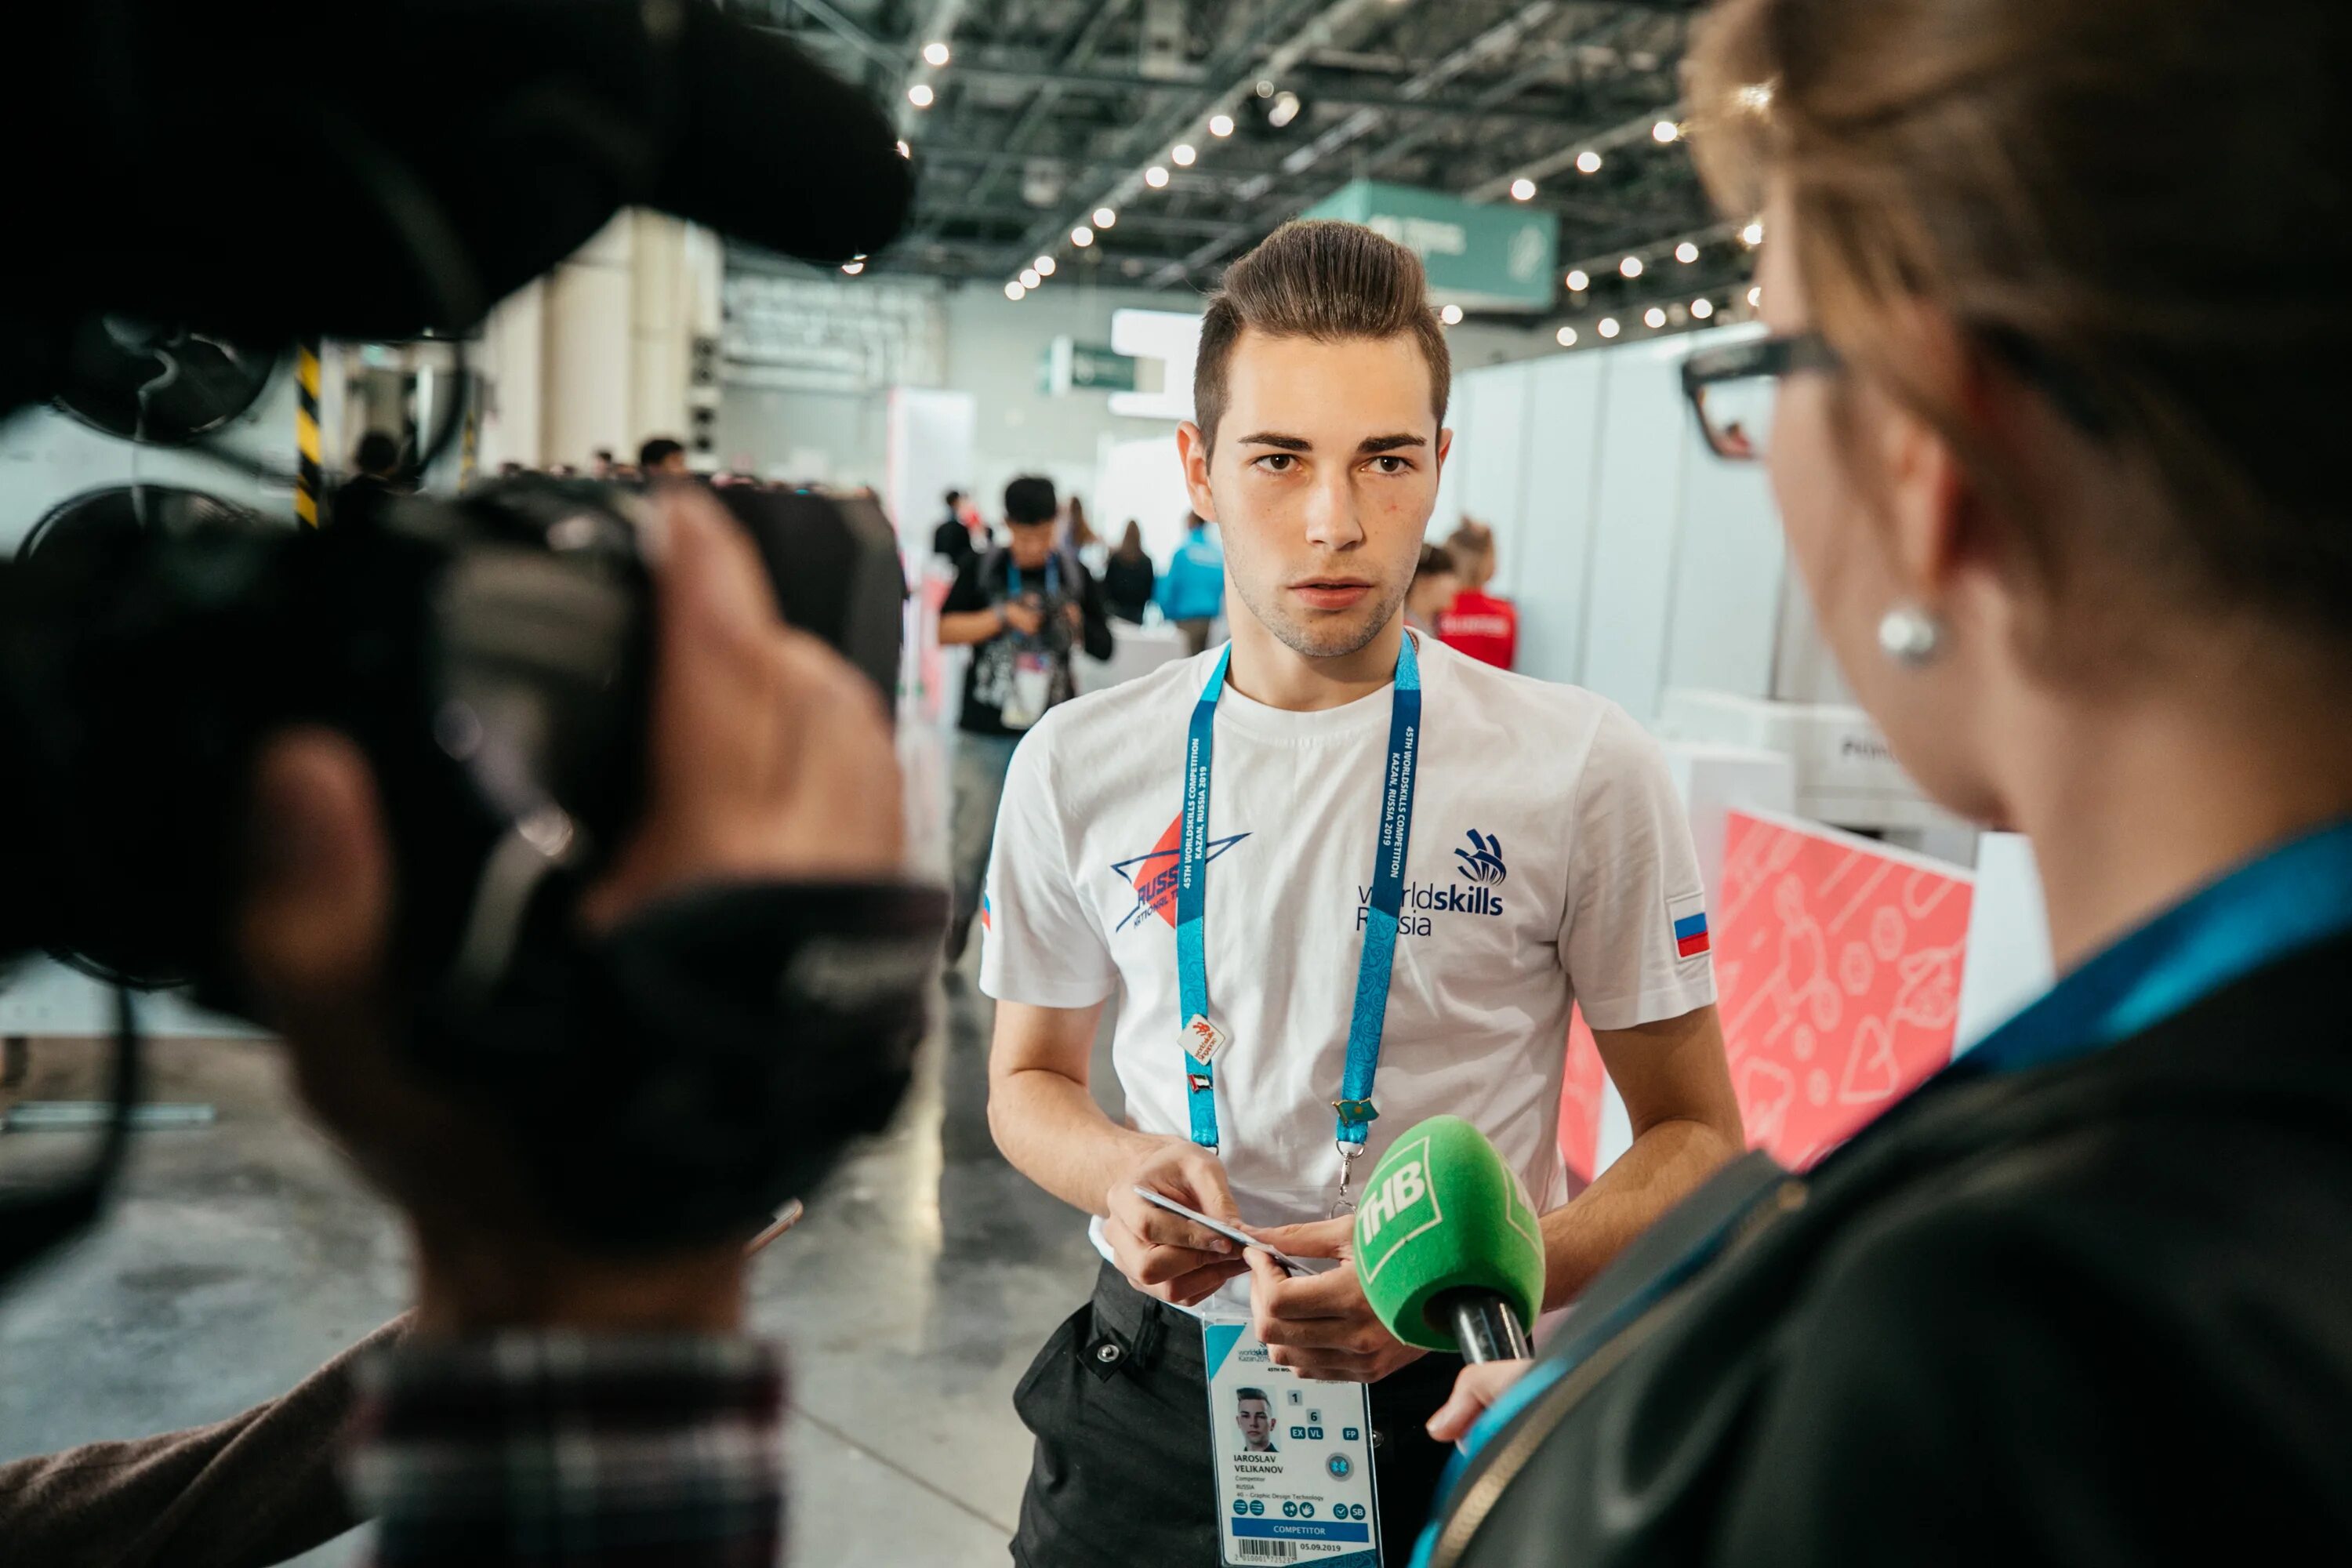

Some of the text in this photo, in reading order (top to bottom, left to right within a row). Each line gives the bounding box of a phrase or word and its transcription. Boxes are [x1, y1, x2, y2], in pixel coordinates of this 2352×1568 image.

[1183, 739, 1200, 890] 45TH WORLDSKILLS COMPETITION
[1194, 766, 1207, 859] KAZAN, RUSSIA 2019
[1383, 753, 1400, 846] KAZAN, RUSSIA 2019
[1390, 726, 1414, 878] 45TH WORLDSKILLS COMPETITION
[1138, 863, 1178, 905] RUSS
[1358, 881, 1504, 916] wrldskills
[1134, 895, 1169, 929] NATIONAL
[1356, 906, 1432, 937] Rsia
[1291, 1393, 1298, 1403] 1
[1310, 1412, 1318, 1421] 6
[1310, 1429, 1321, 1438] VL
[1233, 1454, 1276, 1463] IAROSLAV
[1234, 1465, 1283, 1474] VELIKANOV
[1273, 1526, 1326, 1535] COMPETITOR
[1300, 1543, 1341, 1552] 05.09.2019
